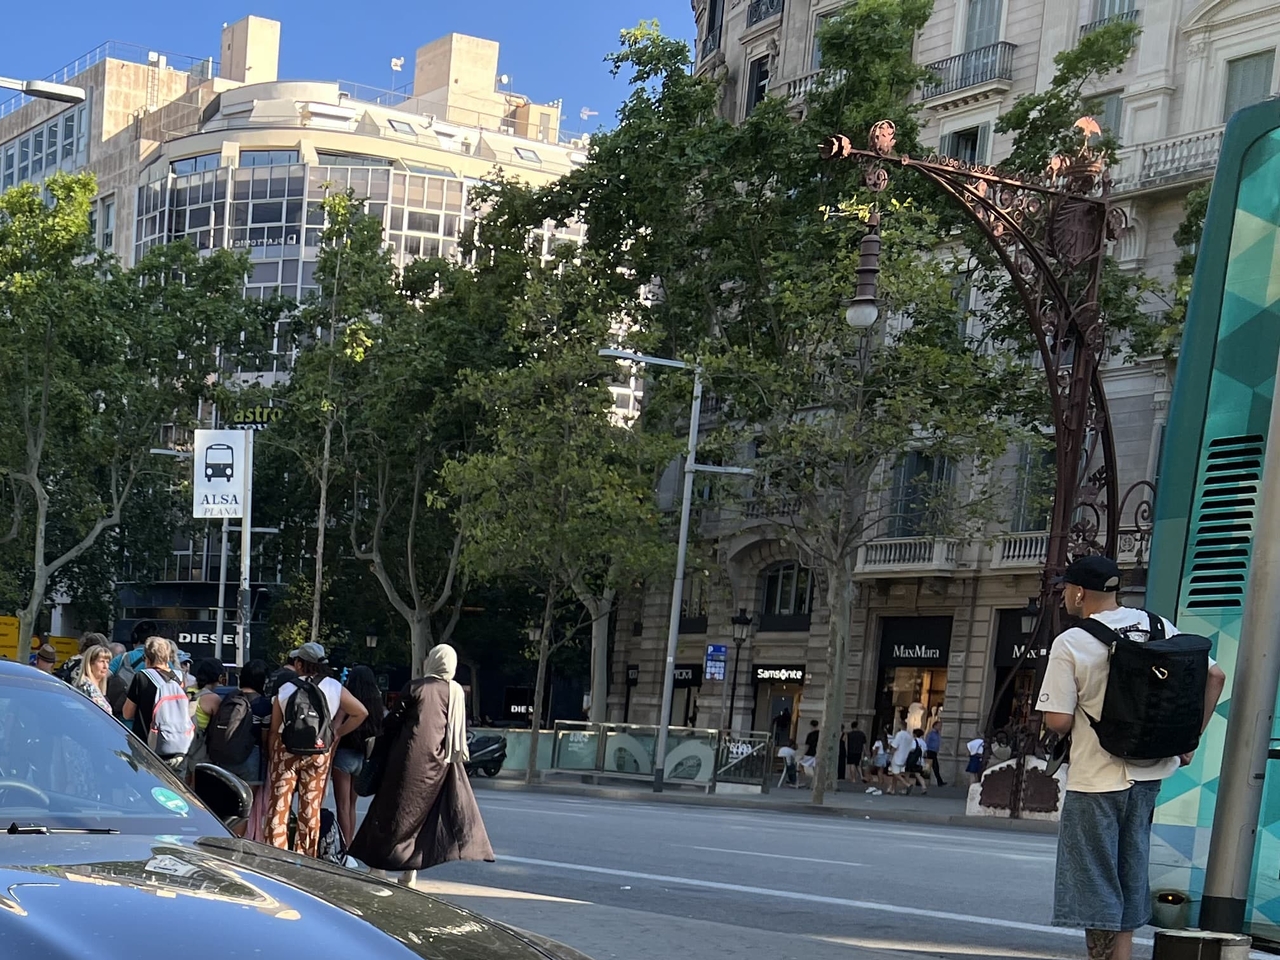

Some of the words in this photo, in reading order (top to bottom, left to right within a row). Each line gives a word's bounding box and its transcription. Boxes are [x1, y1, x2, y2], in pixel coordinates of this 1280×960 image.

[200, 494, 239, 504] ALSA
[203, 507, 238, 516] PLANA
[178, 633, 237, 645] DIESE
[893, 644, 940, 658] MaxMara
[757, 668, 803, 680] Samsonite
[510, 705, 534, 713] DIES
